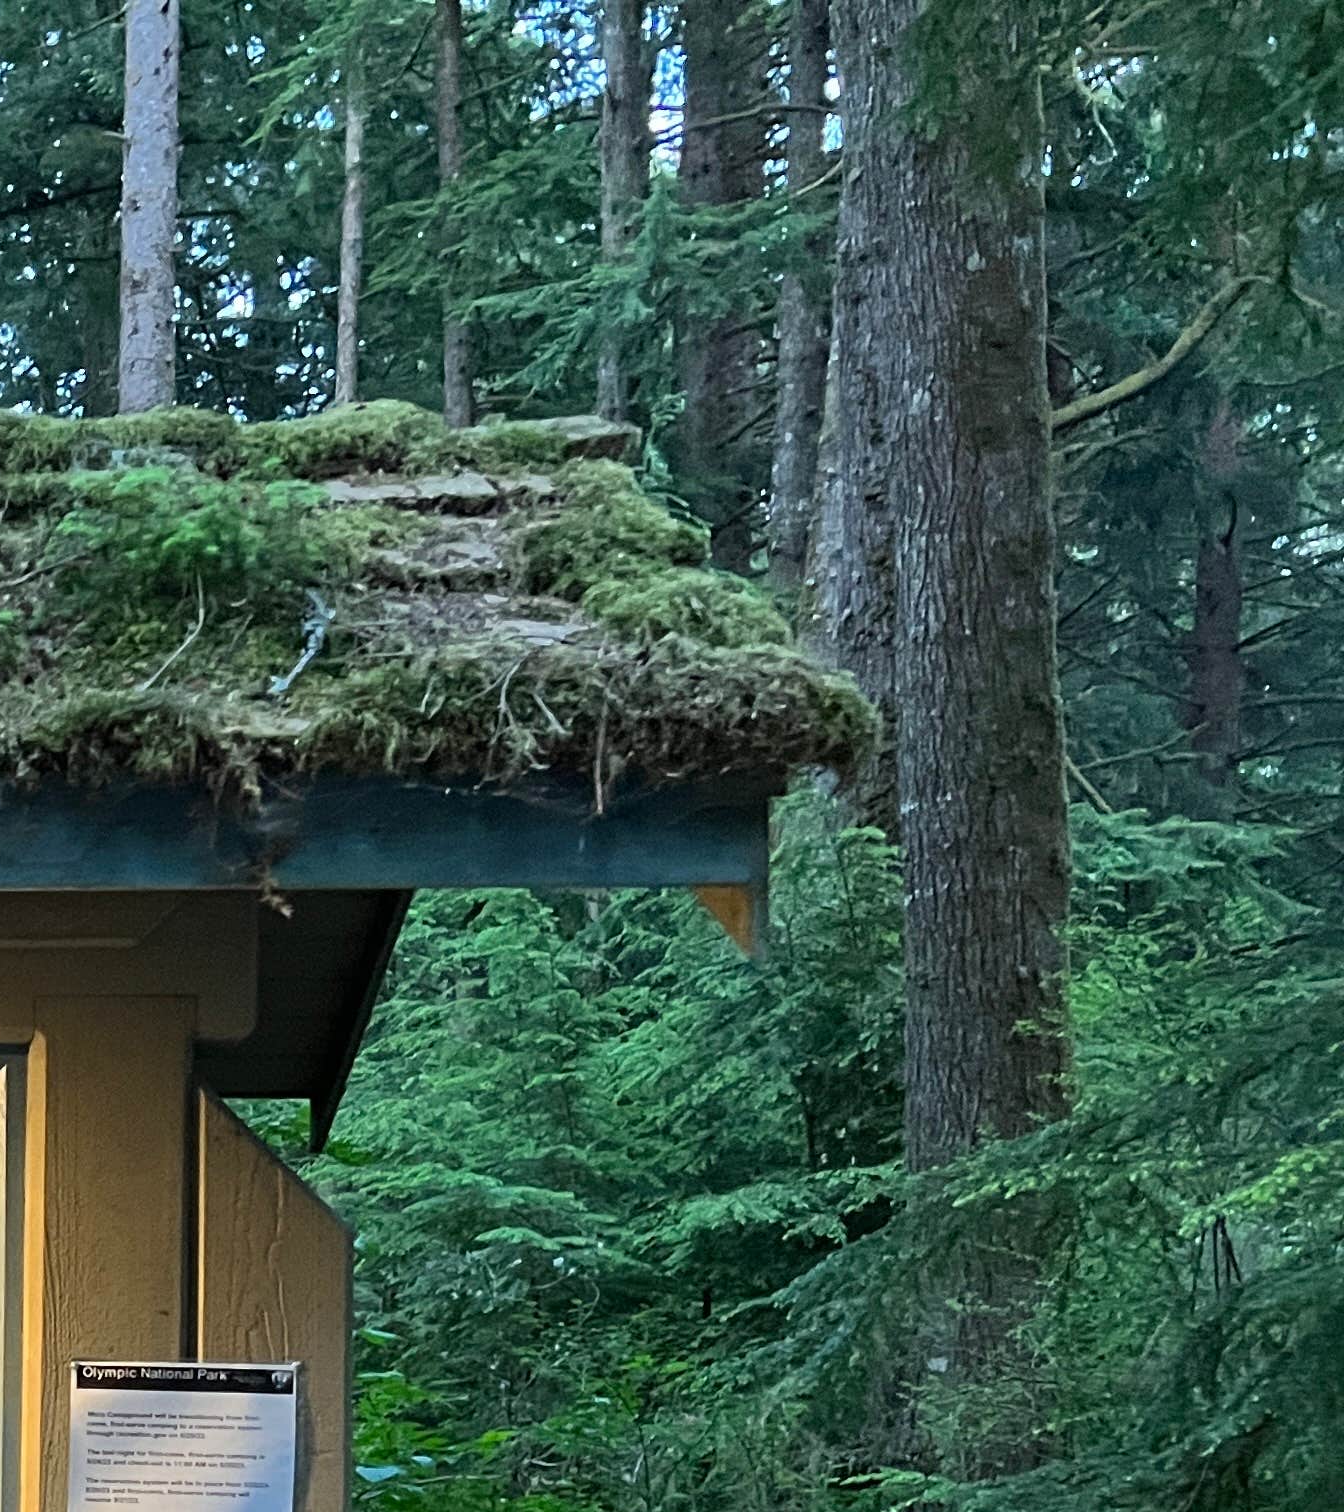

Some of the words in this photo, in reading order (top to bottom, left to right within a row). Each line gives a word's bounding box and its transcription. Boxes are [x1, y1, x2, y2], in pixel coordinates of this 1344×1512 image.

[82, 1366, 137, 1380] Olympic
[140, 1367, 194, 1380] National
[197, 1369, 227, 1381] Park
